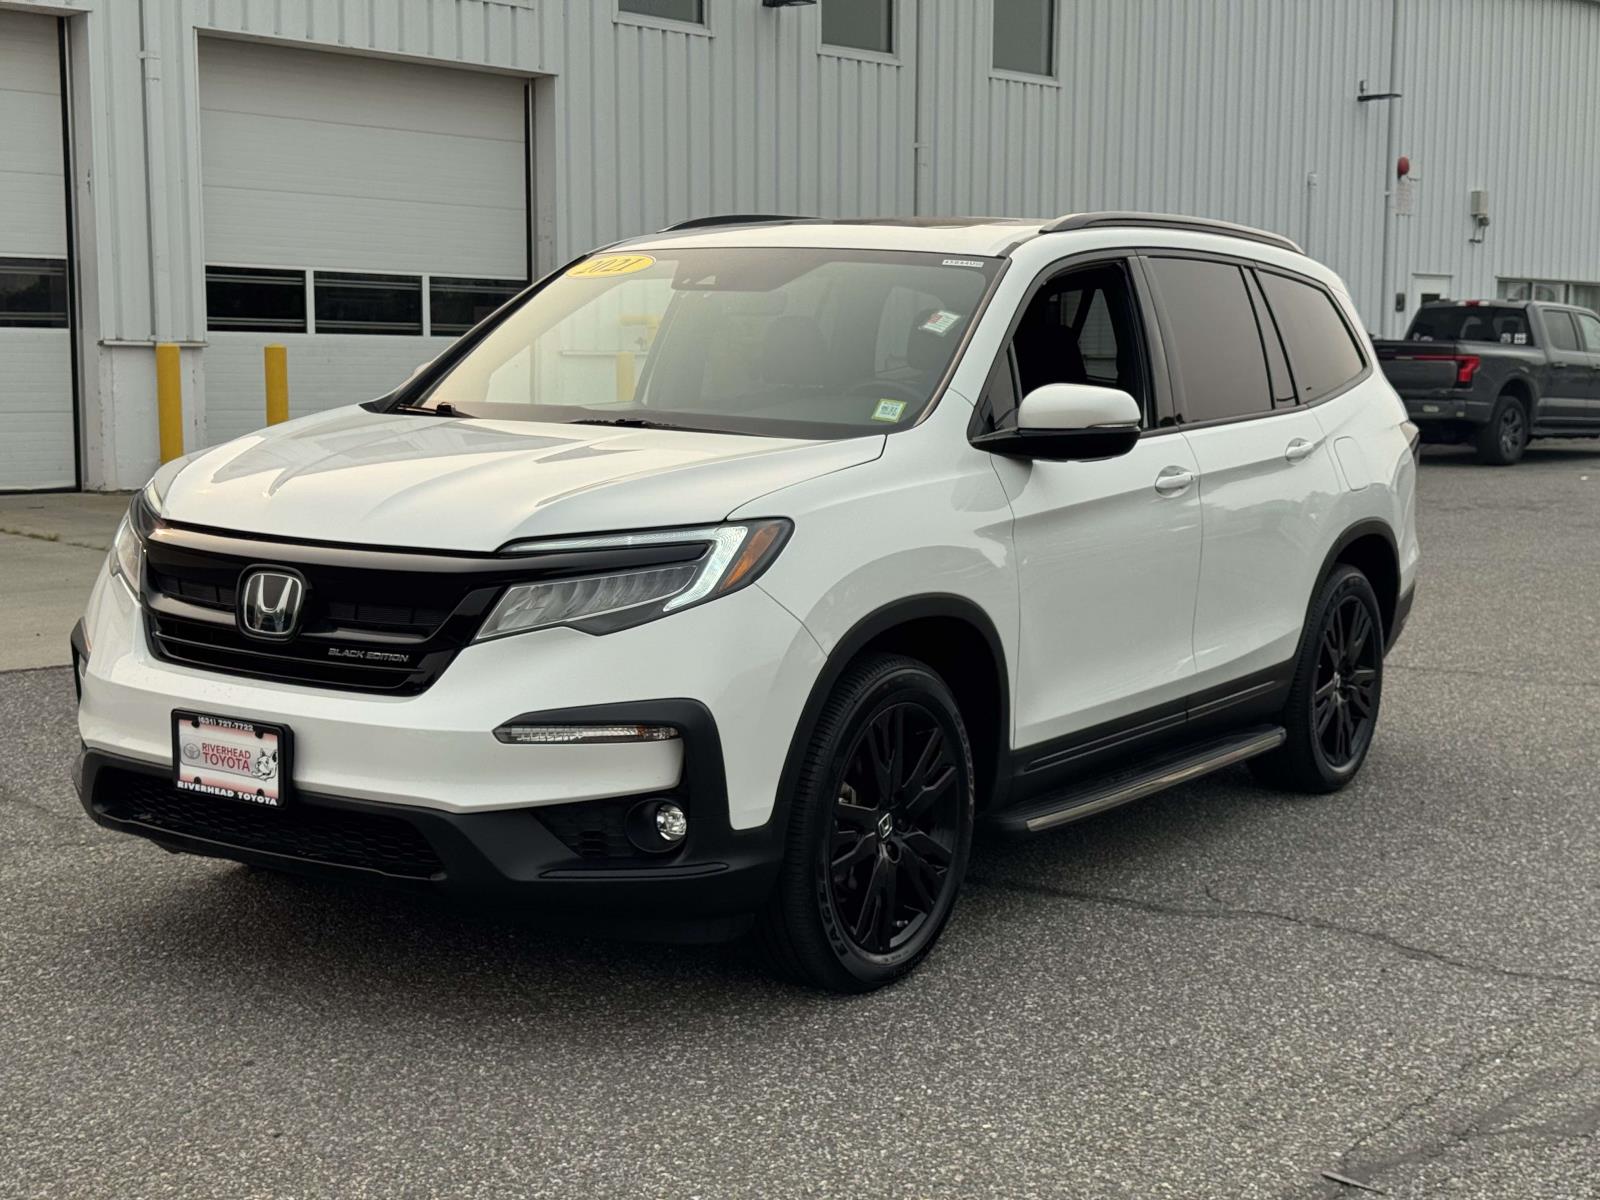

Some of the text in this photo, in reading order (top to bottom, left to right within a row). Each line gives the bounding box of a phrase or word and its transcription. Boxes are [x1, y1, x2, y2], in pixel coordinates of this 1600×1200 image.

[328, 647, 409, 662] BLACK EDITION
[198, 716, 254, 731] (631) 727-7722
[202, 743, 251, 759] RIVERHEAD
[202, 752, 251, 772] TOYOTA
[177, 781, 278, 806] RIVERHEAD TOYOTA
